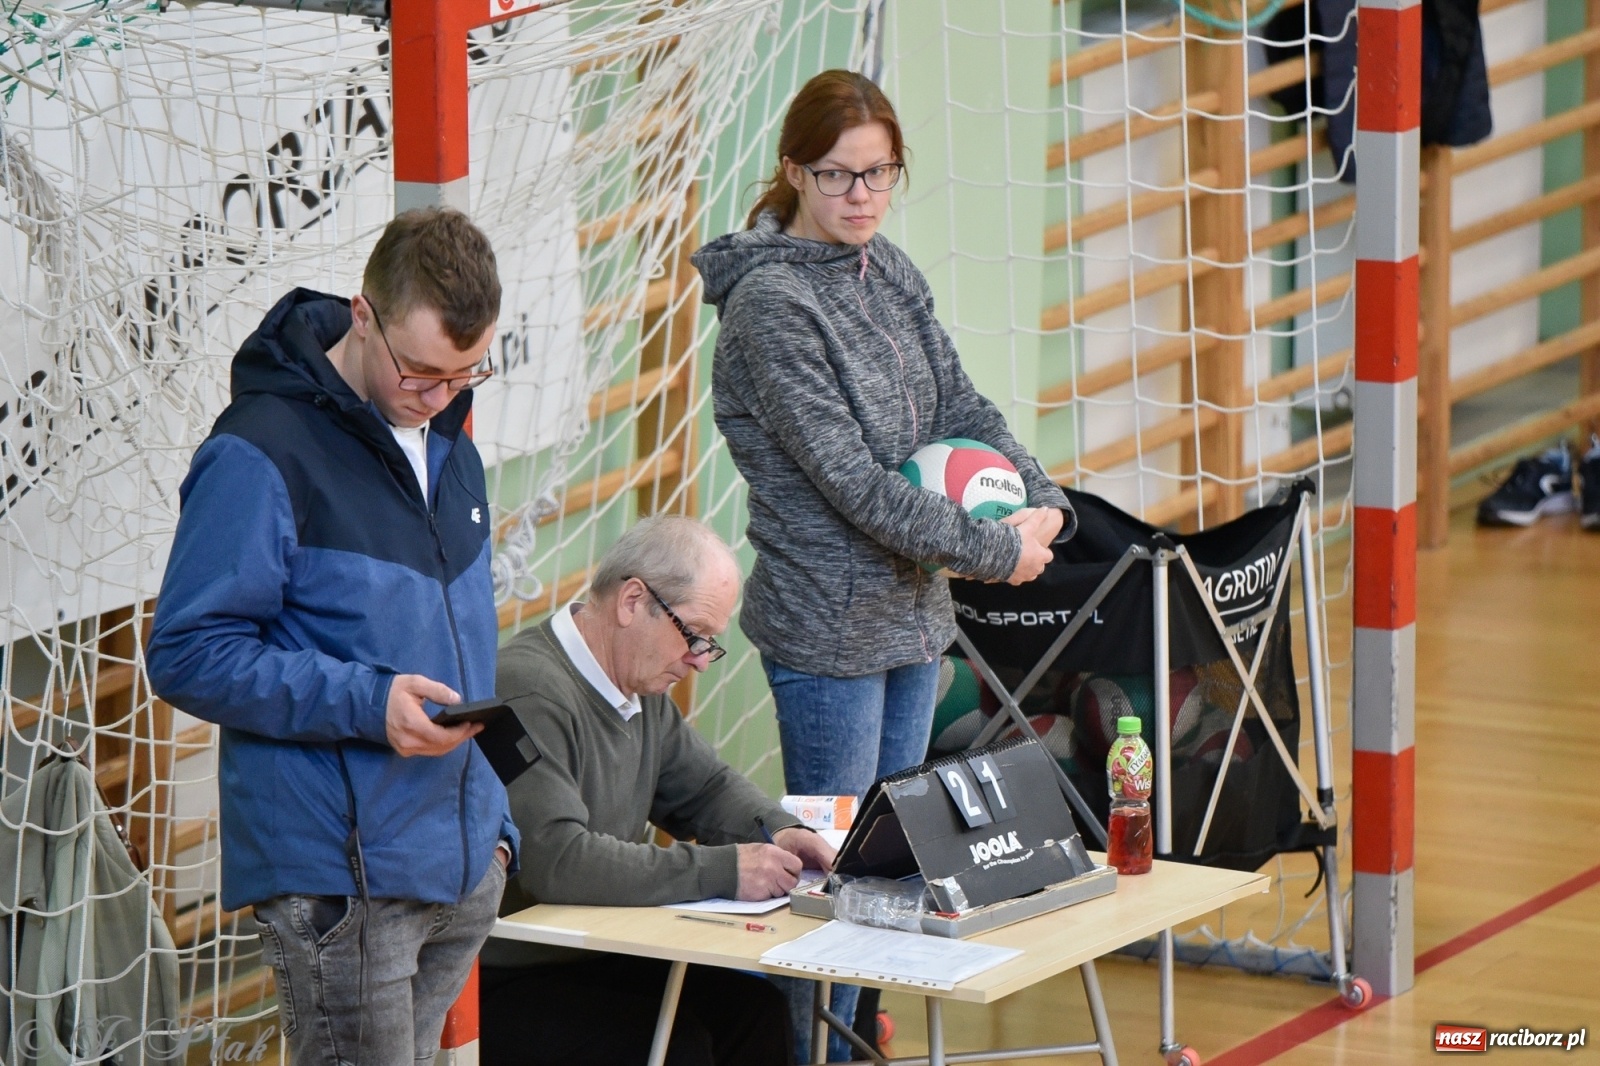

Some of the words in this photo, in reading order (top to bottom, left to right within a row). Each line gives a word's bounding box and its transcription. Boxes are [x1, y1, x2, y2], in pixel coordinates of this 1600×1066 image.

[980, 476, 1023, 499] molten
[947, 770, 982, 817] 2
[981, 761, 1007, 809] 1
[969, 831, 1023, 864] JOOLA
